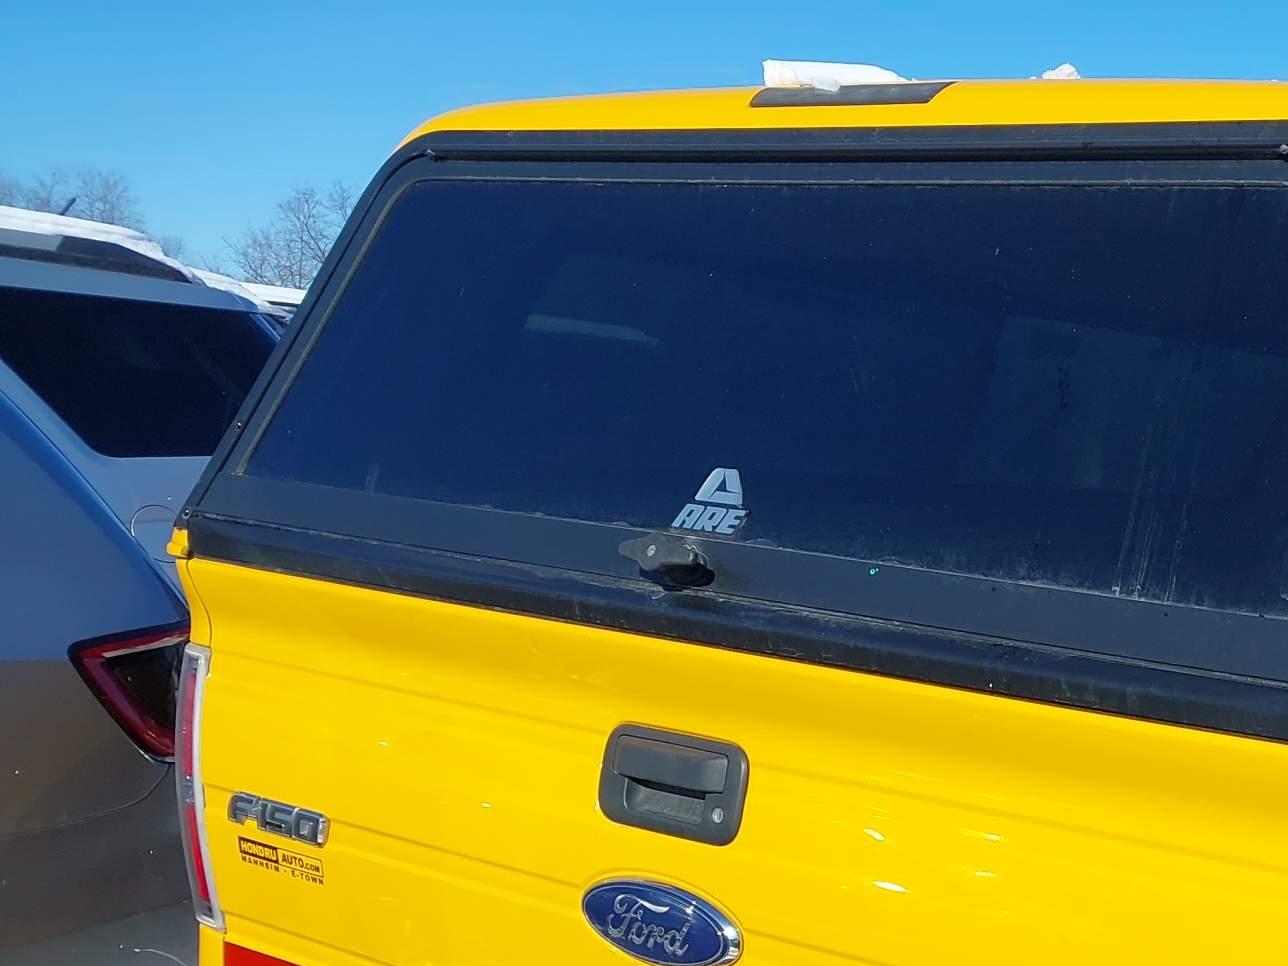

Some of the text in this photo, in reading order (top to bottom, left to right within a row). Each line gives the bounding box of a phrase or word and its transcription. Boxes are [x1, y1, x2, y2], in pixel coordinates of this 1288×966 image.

[671, 503, 747, 535] ARE
[240, 855, 324, 885] MANHEIM E-TOWN
[607, 893, 692, 957] Ford
